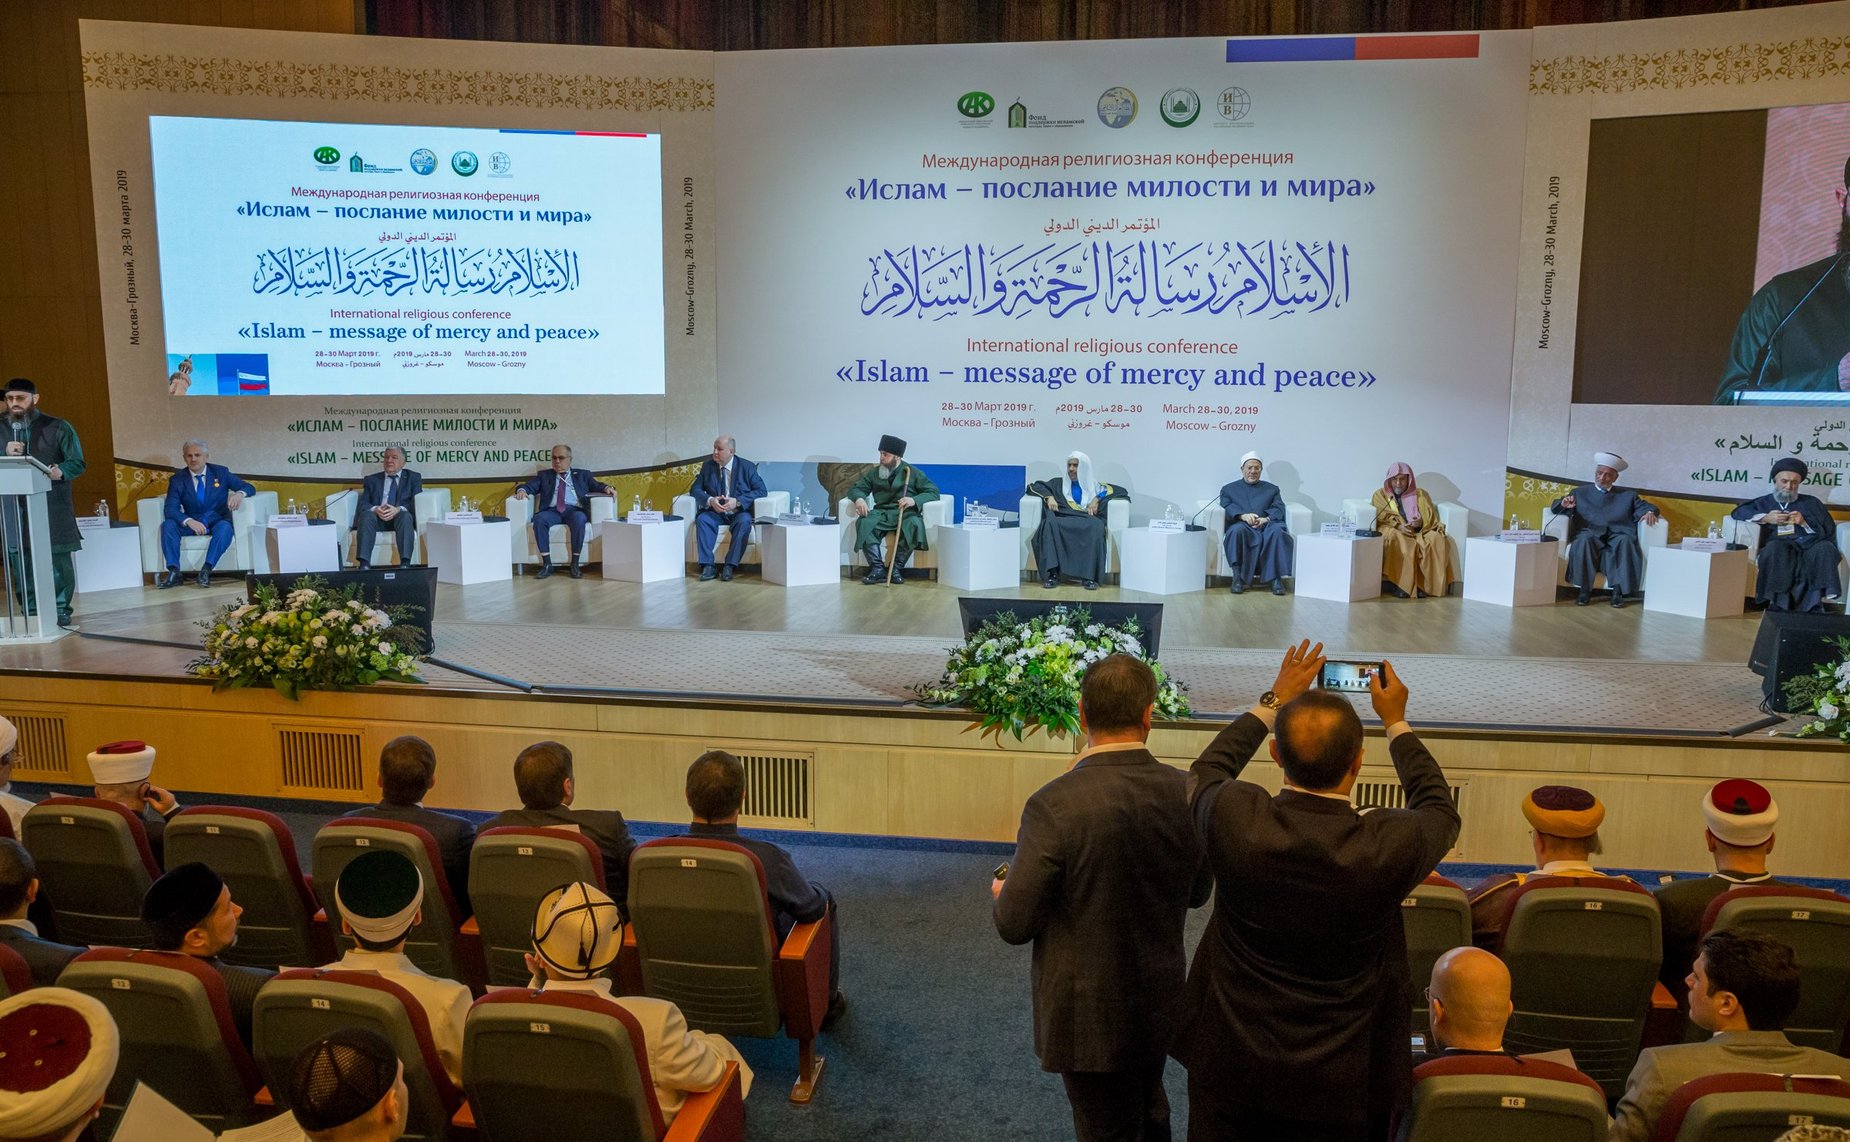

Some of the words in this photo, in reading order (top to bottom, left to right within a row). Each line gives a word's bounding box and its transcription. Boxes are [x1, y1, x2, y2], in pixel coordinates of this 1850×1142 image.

[923, 154, 1059, 171] Международная
[1064, 155, 1171, 170] религиозная
[1176, 150, 1293, 168] конференция
[117, 170, 128, 191] 2019
[684, 178, 693, 197] 2019
[1549, 176, 1560, 197] 2019
[292, 187, 387, 200] Международная
[390, 191, 461, 200] религиозная
[464, 191, 539, 203] конференция
[846, 179, 947, 200] «Ислам
[982, 181, 1117, 198] послание
[1128, 180, 1250, 197] милости
[1260, 180, 1277, 196] и
[1288, 180, 1375, 202] мира»
[121, 195, 132, 225] марта
[237, 201, 310, 217] «Ислам
[334, 207, 427, 219] послание
[433, 209, 513, 220] милости
[519, 211, 530, 221] и
[537, 211, 591, 225] мира»
[684, 200, 694, 230] March,
[1546, 201, 1559, 234] March,
[124, 260, 139, 345] Москва-Грозный,
[686, 262, 696, 335] Moscow-Grozny,
[331, 309, 400, 318] International
[404, 309, 449, 321] religious
[452, 309, 511, 319] conference
[1539, 269, 1555, 349] Moscow-Grozny,
[238, 322, 305, 338] «Islam
[330, 327, 406, 342] message
[413, 323, 432, 338] of
[436, 328, 491, 342] mercy
[497, 324, 530, 339] and
[535, 329, 599, 342] peace»
[968, 338, 1068, 352] International
[1075, 338, 1142, 356] religious
[1148, 339, 1237, 354] conference
[837, 360, 929, 382] «Islam
[964, 367, 1076, 389] message
[1086, 361, 1116, 384] of
[1121, 369, 1205, 391] mercy
[1214, 363, 1266, 386] and
[1274, 370, 1376, 392] peace»
[324, 407, 398, 416] Международная
[461, 406, 521, 416] конференция
[975, 402, 1002, 413] Март
[1004, 403, 1026, 411] 2019
[1163, 404, 1195, 413] March
[288, 420, 343, 432] «ИСЛАМ
[360, 419, 428, 431] ПОСЛАНИЕ
[434, 419, 495, 431] МИЛОСТИ
[500, 419, 507, 430] И
[513, 419, 557, 430] МИРА»
[943, 418, 981, 426] Москва
[991, 418, 1035, 429] Грозный
[1166, 421, 1209, 430] Moscow
[1219, 421, 1256, 433] Grozny
[353, 439, 409, 447] International
[412, 439, 448, 448] religious
[288, 452, 336, 464] «ISLAM
[353, 451, 412, 463] MESSE
[416, 451, 431, 462] OF
[437, 450, 479, 462] MERCY
[484, 450, 509, 462] AND
[1691, 468, 1748, 483] «ISLAM
[1768, 472, 1844, 487] SAGE
[1507, 1098, 1519, 1106] 16
